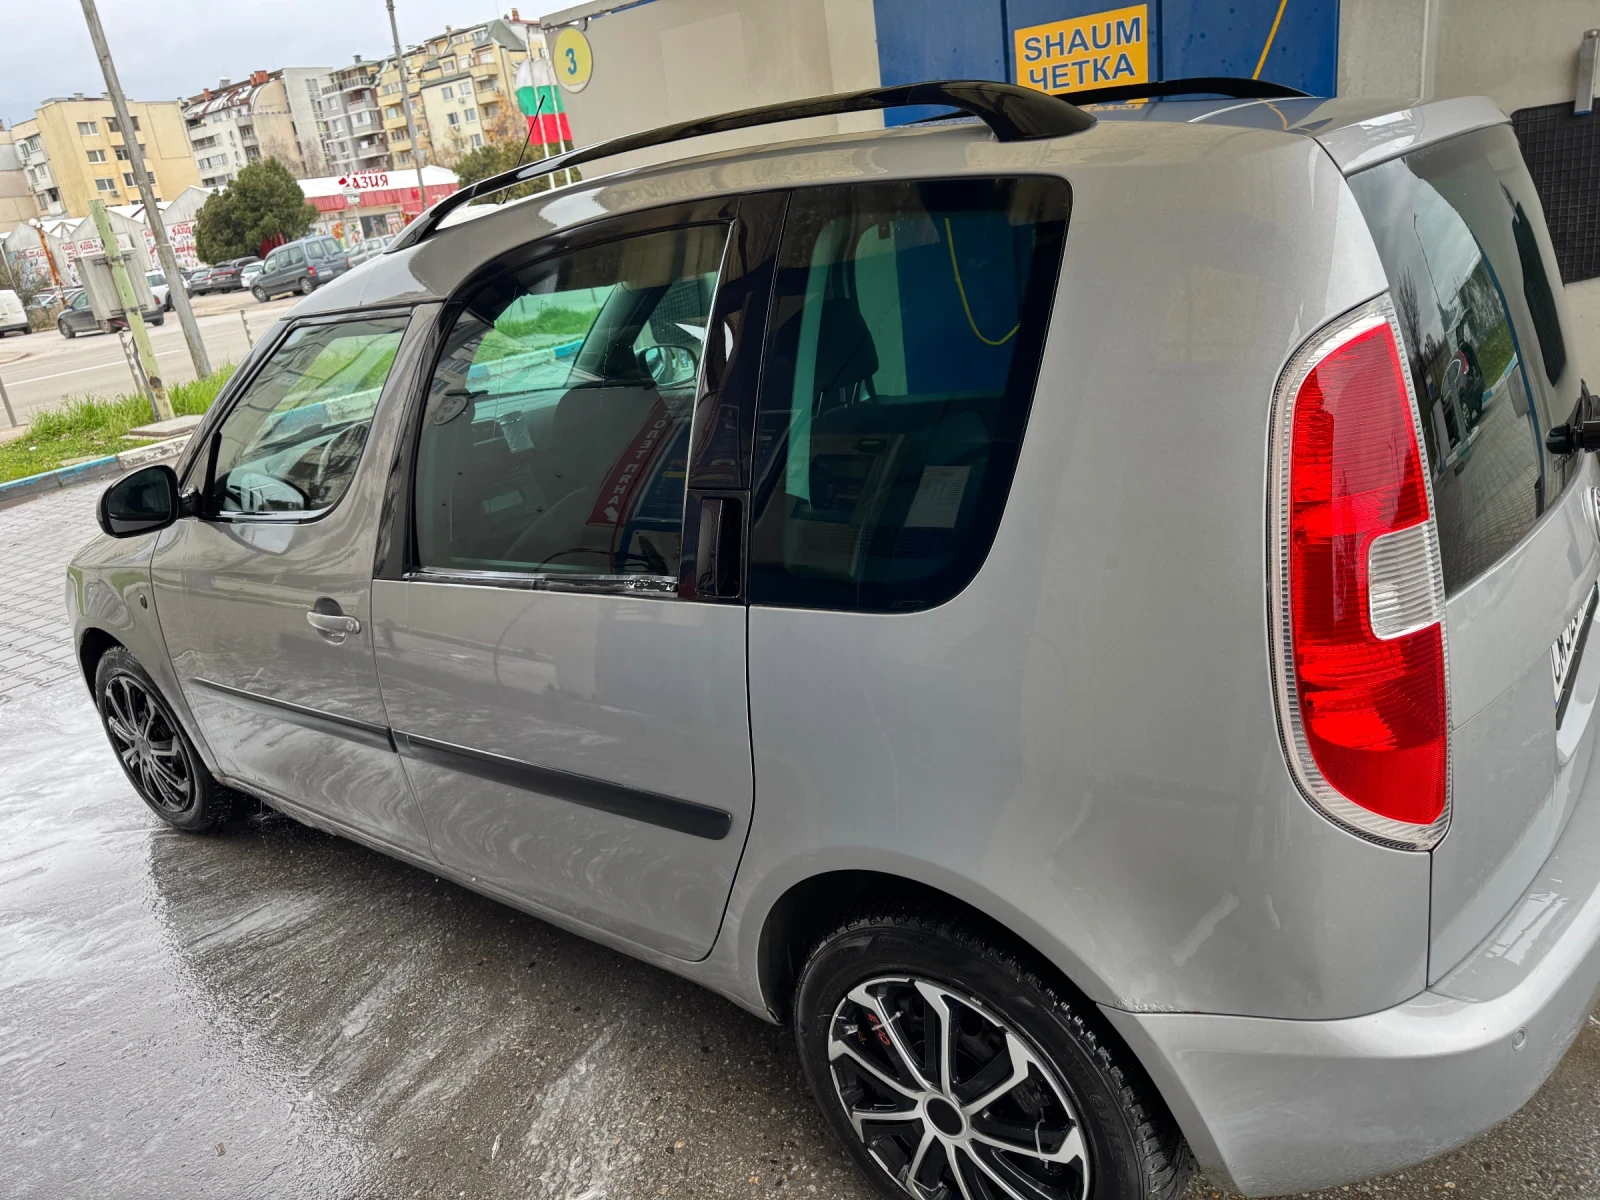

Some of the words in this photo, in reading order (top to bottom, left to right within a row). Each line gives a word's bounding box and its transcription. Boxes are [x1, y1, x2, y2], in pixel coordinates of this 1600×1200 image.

[1023, 16, 1141, 63] SHAUM
[565, 47, 578, 76] 3
[1028, 52, 1136, 91] ЧЕТКА
[352, 174, 389, 189] АЗИЯ
